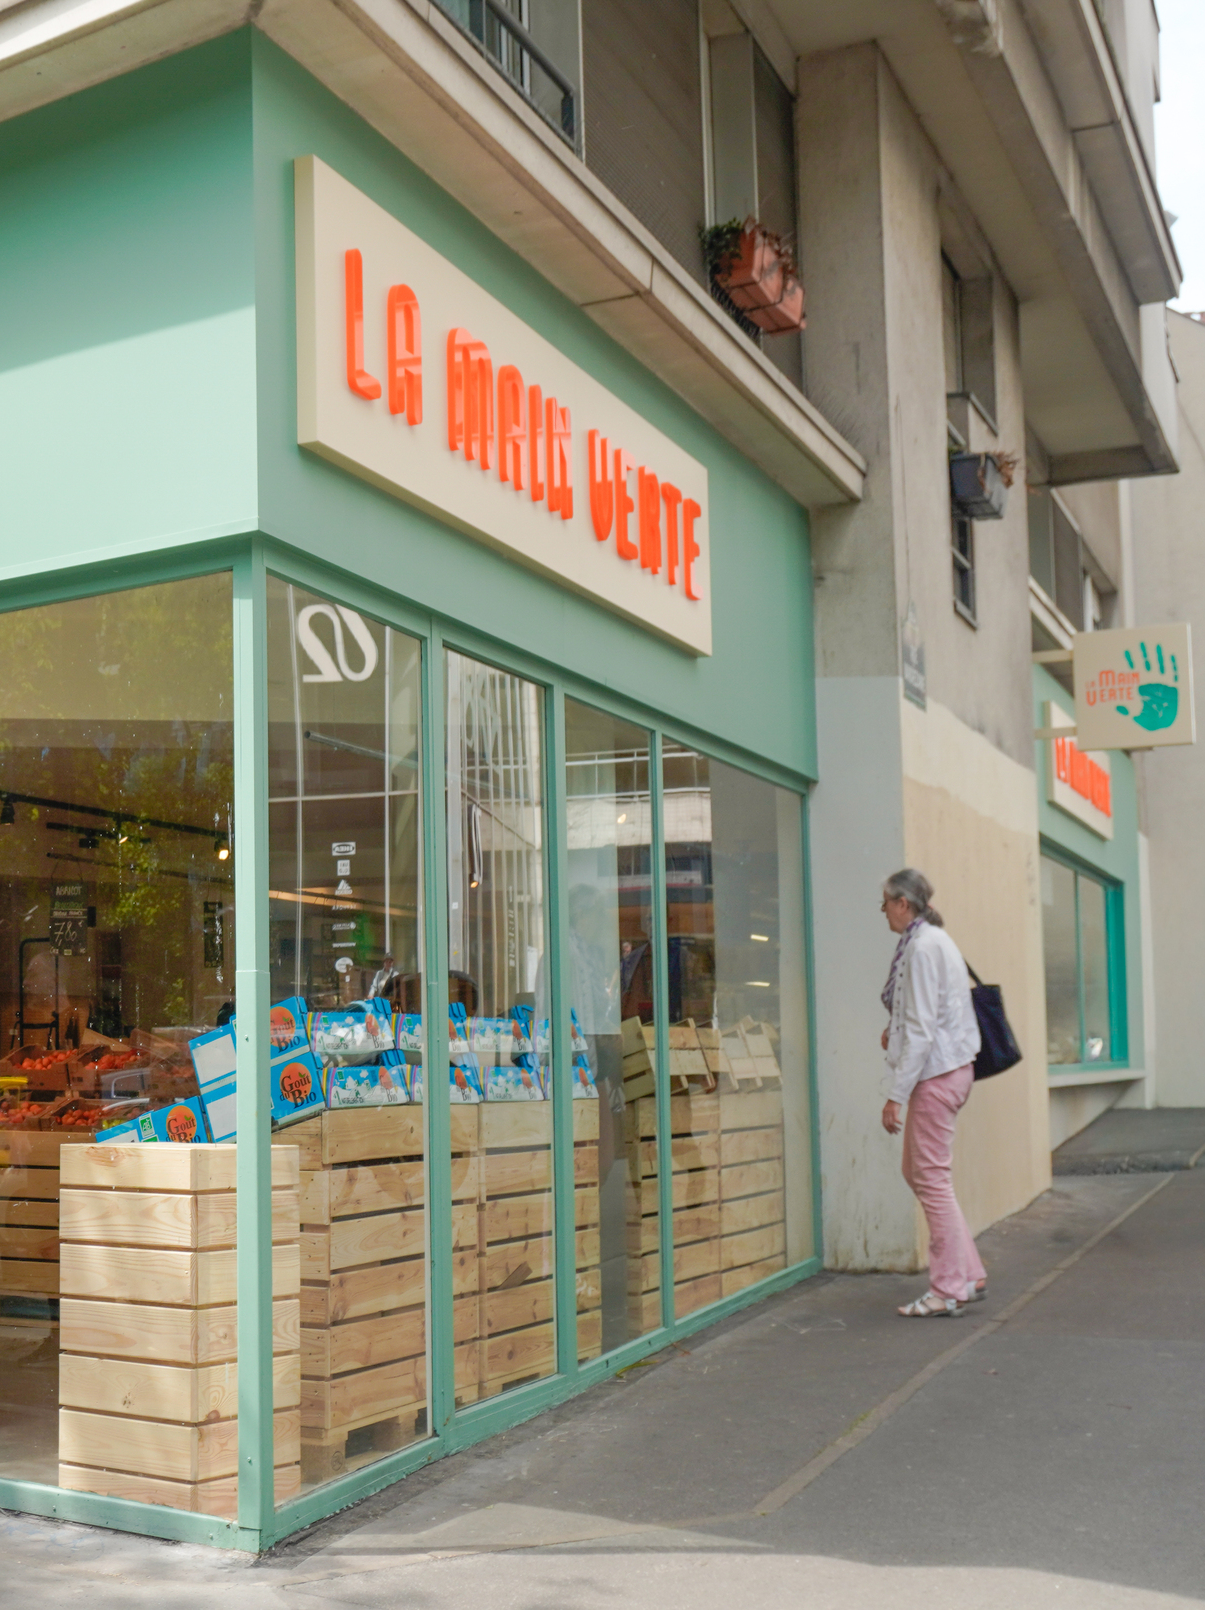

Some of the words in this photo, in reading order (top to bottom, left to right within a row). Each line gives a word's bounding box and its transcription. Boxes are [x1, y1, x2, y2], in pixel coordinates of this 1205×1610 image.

[345, 248, 423, 427] LA
[446, 327, 574, 521] MAIN
[588, 428, 704, 601] VERTE
[290, 1088, 317, 1109] Bio
